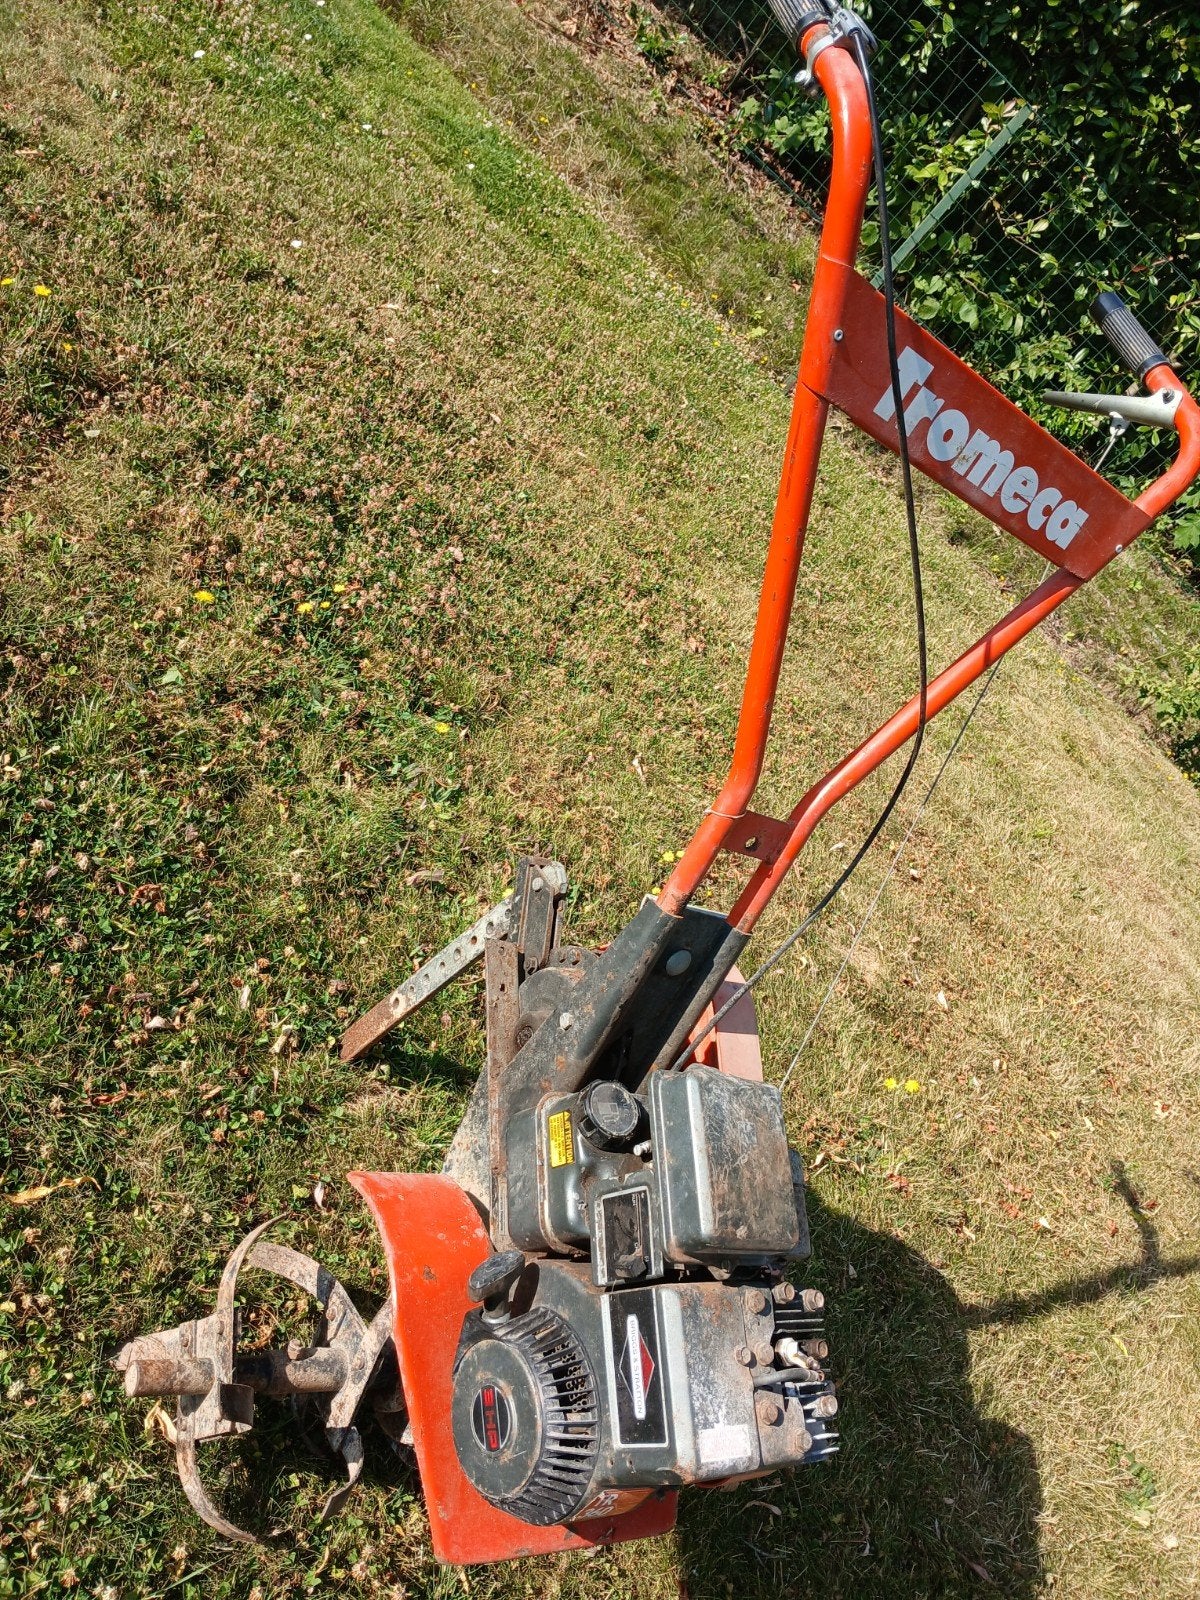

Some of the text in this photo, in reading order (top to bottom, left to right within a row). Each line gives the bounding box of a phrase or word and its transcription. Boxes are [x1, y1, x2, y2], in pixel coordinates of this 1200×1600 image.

[874, 346, 1089, 550] Tromeca
[564, 1120, 574, 1163] ATTENTION
[629, 1319, 638, 1356] BRIGGS
[633, 1364, 643, 1414] STRATTON
